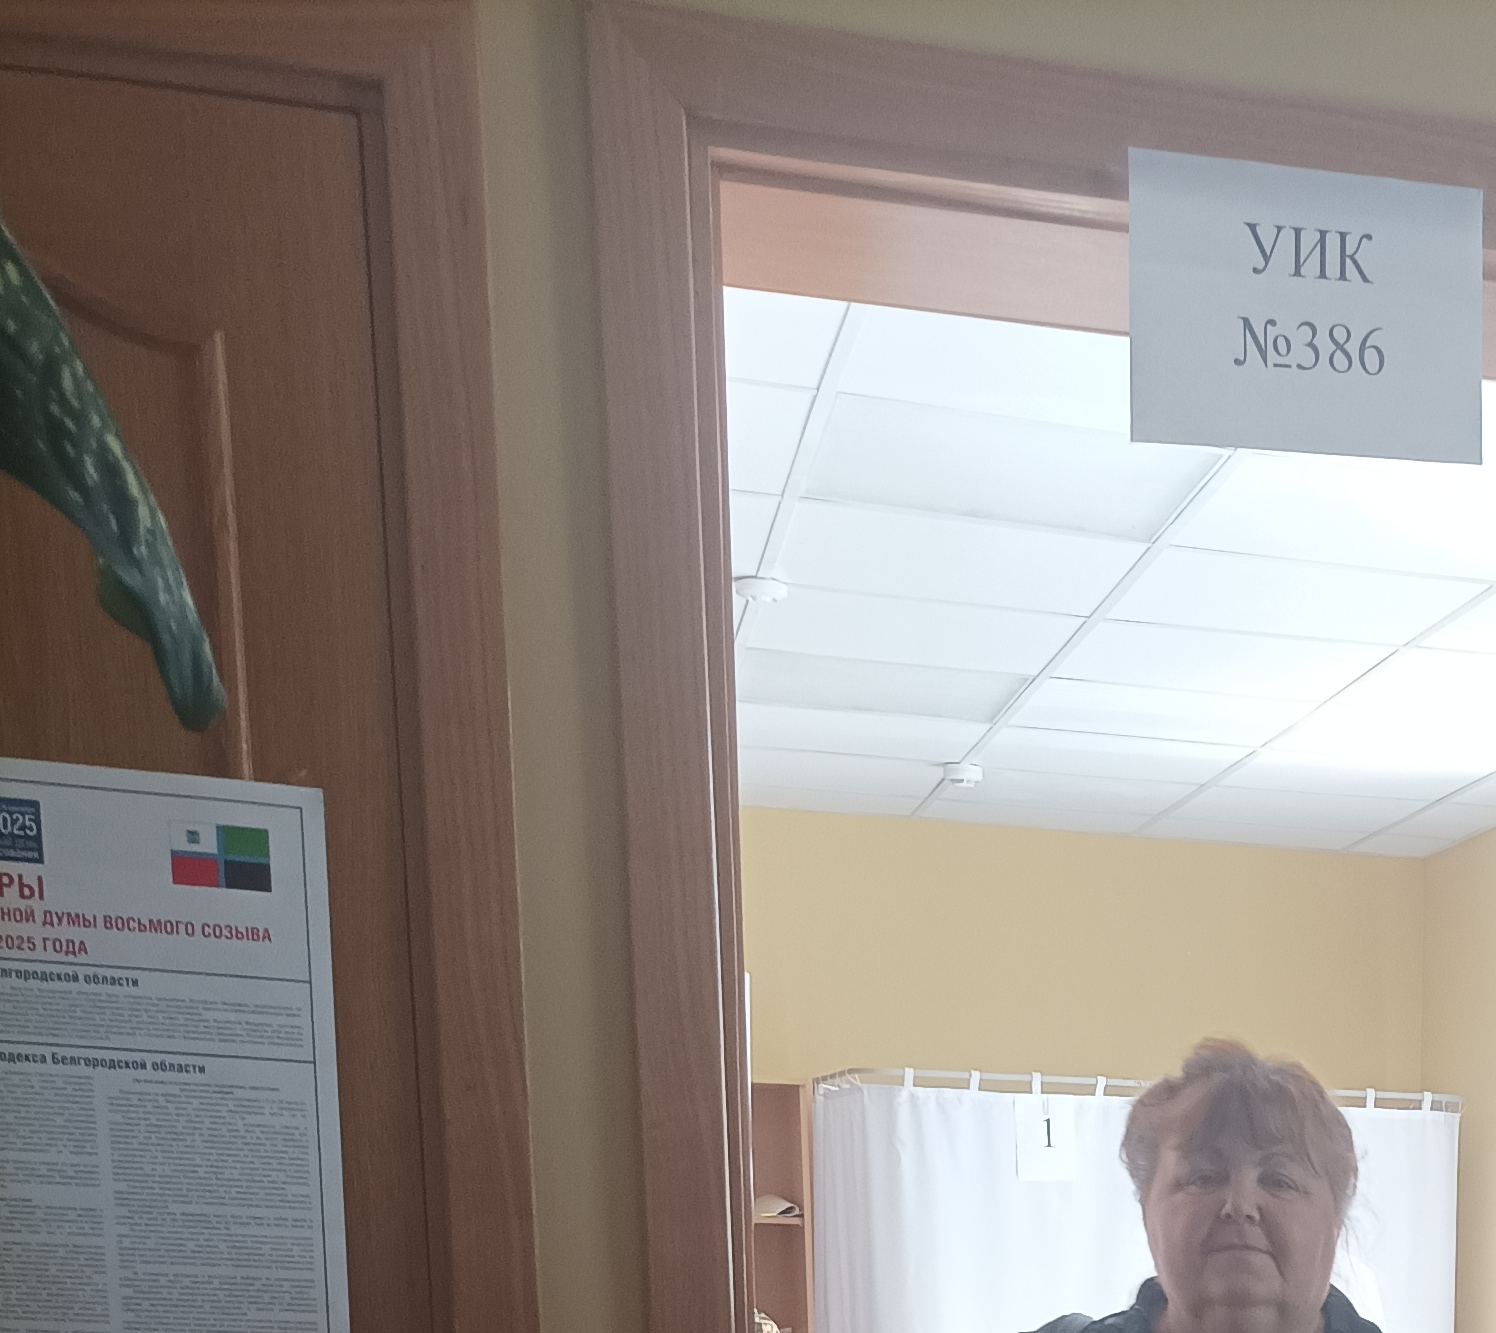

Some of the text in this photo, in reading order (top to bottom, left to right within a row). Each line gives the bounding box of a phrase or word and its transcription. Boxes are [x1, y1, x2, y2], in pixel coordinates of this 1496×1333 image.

[1242, 221, 1375, 285] УИК
[1233, 315, 1386, 376] №386
[41, 909, 98, 930] ДУМЫ
[103, 915, 196, 938] ВОСЬМОГО
[201, 922, 273, 944] СОЗЫВА
[42, 936, 89, 958] ГОДА
[83, 973, 140, 988] области
[51, 1052, 147, 1071] Белгородской
[151, 1059, 206, 1075] области
[1042, 1117, 1055, 1148] 1
